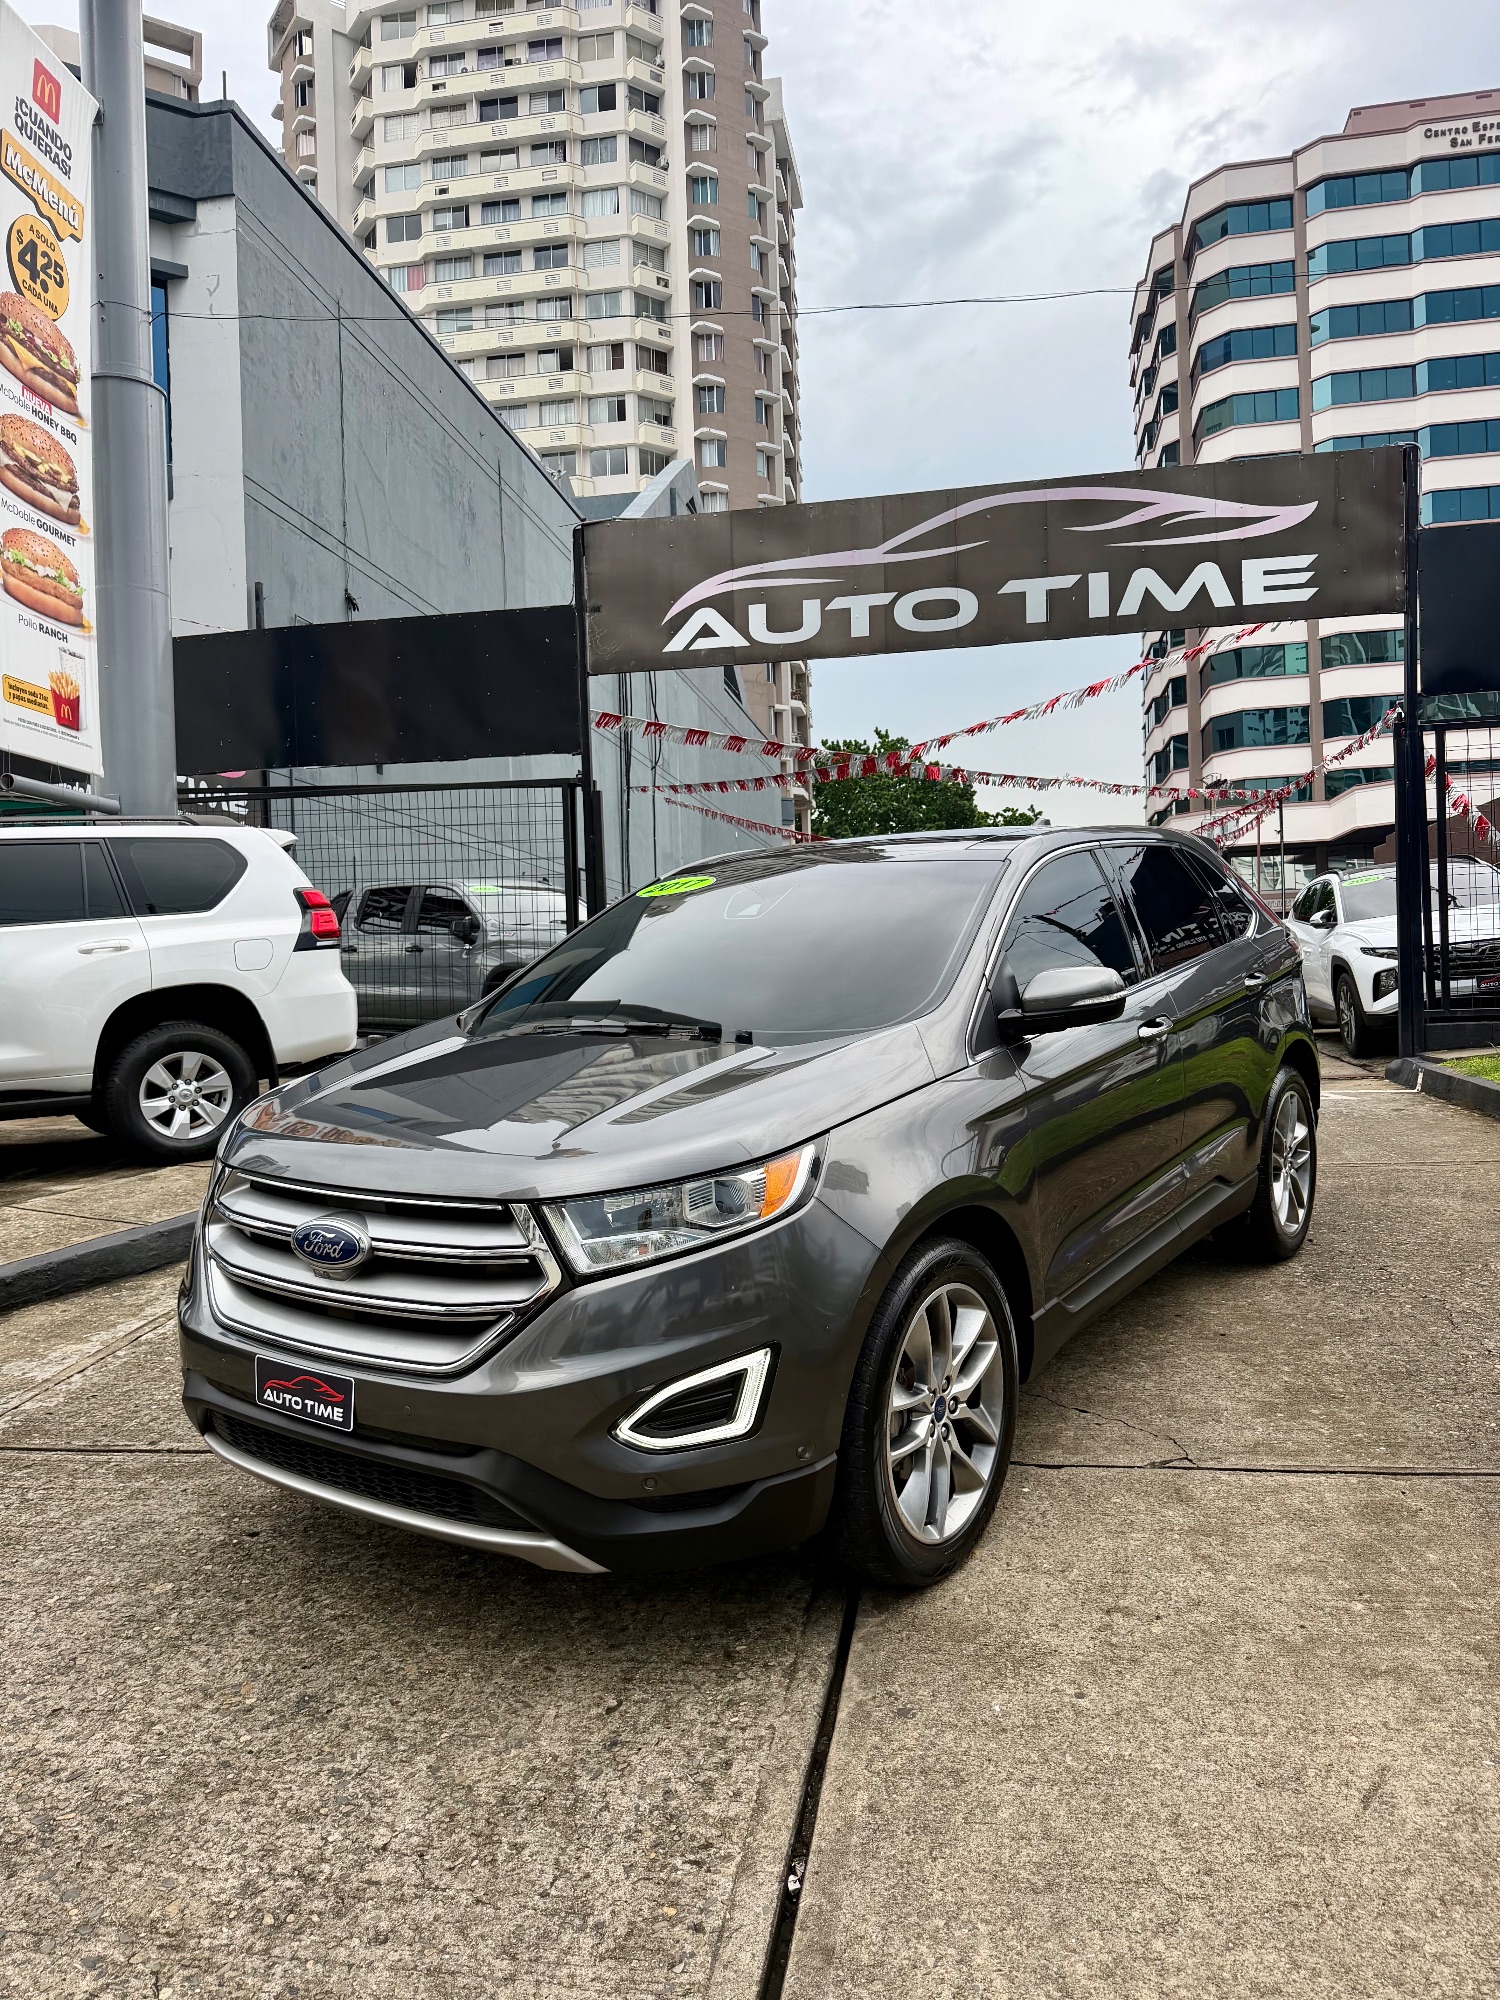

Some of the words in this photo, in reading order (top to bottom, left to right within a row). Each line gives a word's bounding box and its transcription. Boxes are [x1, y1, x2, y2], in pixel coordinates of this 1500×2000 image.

[15, 96, 73, 161] ¡CUANDO
[1424, 127, 1469, 138] CENTRO
[1450, 137, 1473, 148] SAN
[14, 113, 72, 180] QUIERAS!
[5, 143, 80, 231] McMenú
[29, 224, 35, 235] A
[35, 230, 56, 252] SOLO
[22, 279, 42, 302] CADA
[43, 296, 59, 315] UNA
[24, 389, 51, 414] NUEVA
[31, 406, 59, 431] HONEY
[60, 425, 77, 446] BBQ
[1, 497, 36, 526] McDoble
[36, 518, 77, 547] GOURMET
[661, 585, 979, 652] AUTO
[998, 553, 1320, 623] TIME
[18, 613, 38, 631] Pollo
[38, 622, 69, 644] RANCH
[12, 692, 26, 703] papas
[304, 1229, 343, 1259] Ford
[263, 1388, 303, 1410] AUTO
[303, 1399, 344, 1422] TIME
